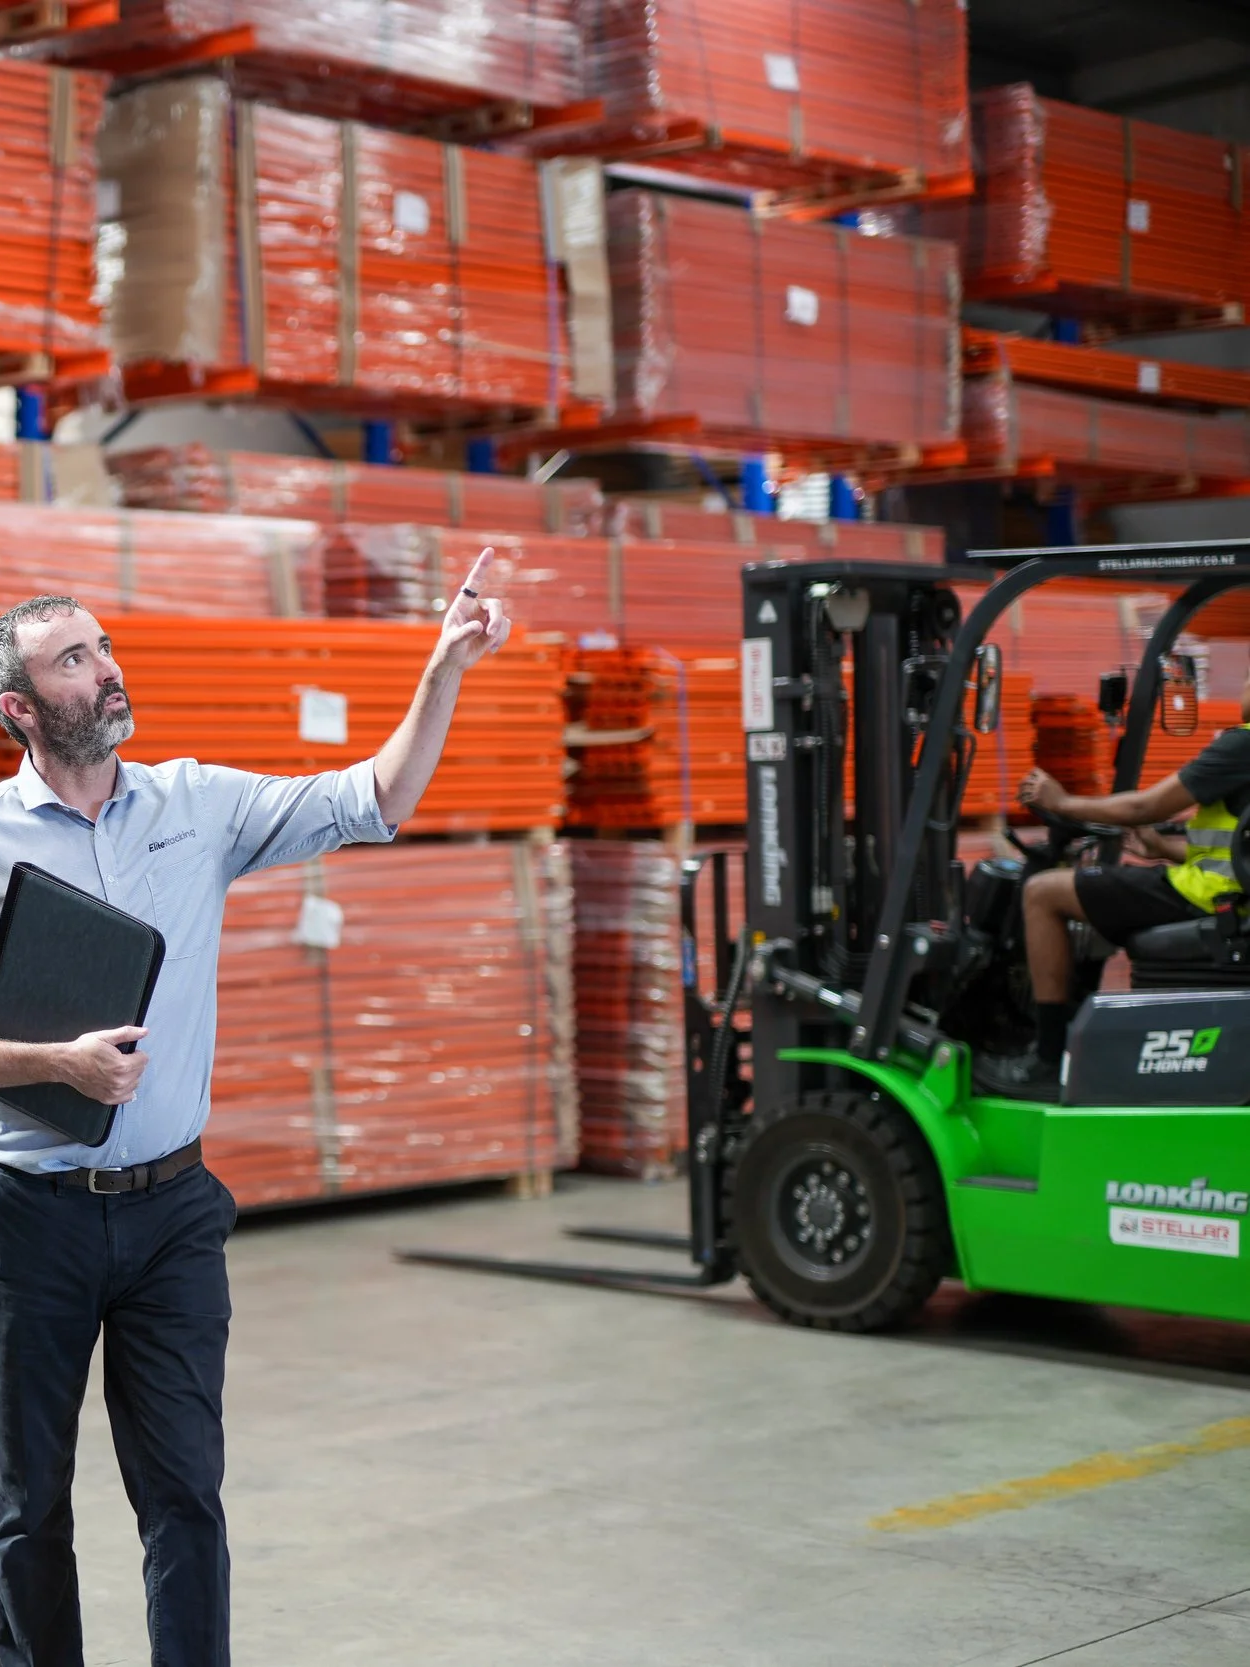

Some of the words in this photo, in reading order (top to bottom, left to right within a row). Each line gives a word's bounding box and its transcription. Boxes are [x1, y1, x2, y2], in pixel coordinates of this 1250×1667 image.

[1099, 554, 1236, 571] STELLARMACHINERY.CO.NZ
[148, 828, 196, 853] EliteRacking
[1141, 1029, 1194, 1059] 25
[1141, 1217, 1230, 1241] STELLAR
